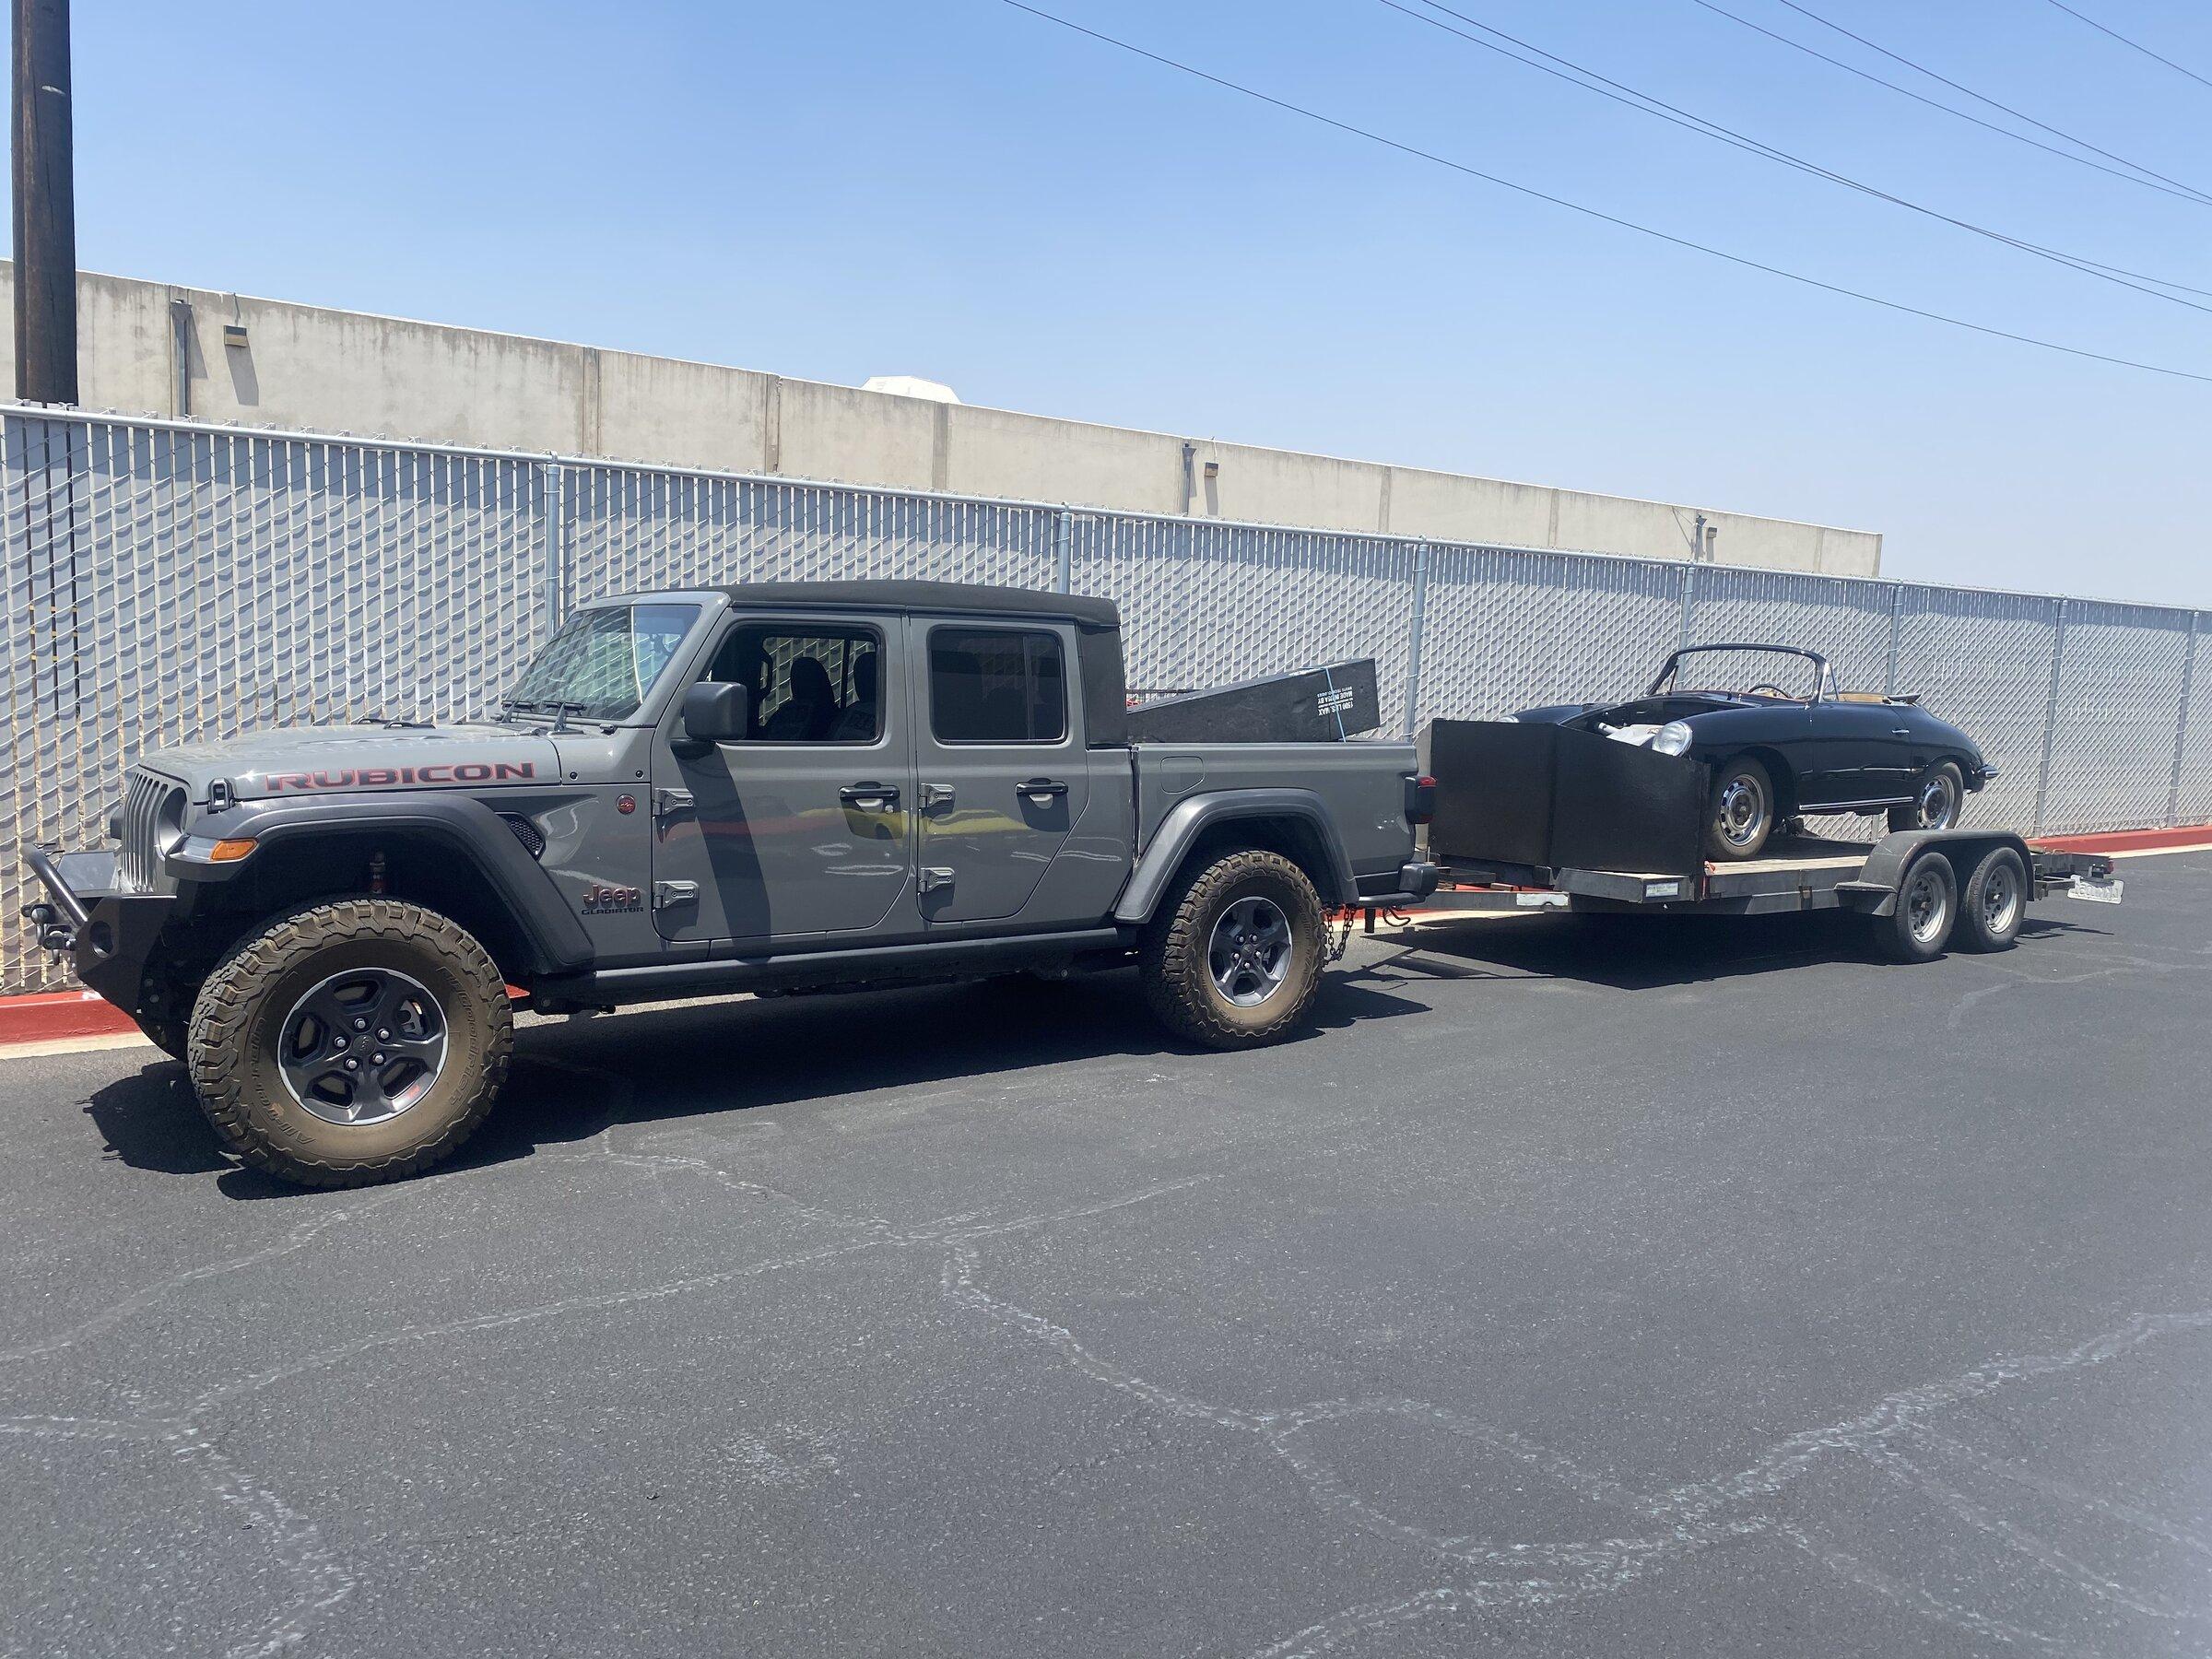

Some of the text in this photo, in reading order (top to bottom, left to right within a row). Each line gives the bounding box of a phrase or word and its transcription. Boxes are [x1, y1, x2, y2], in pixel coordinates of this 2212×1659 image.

[265, 762, 535, 791] RUBICON
[583, 884, 641, 909] Jeep
[582, 907, 643, 915] GLADIATOR
